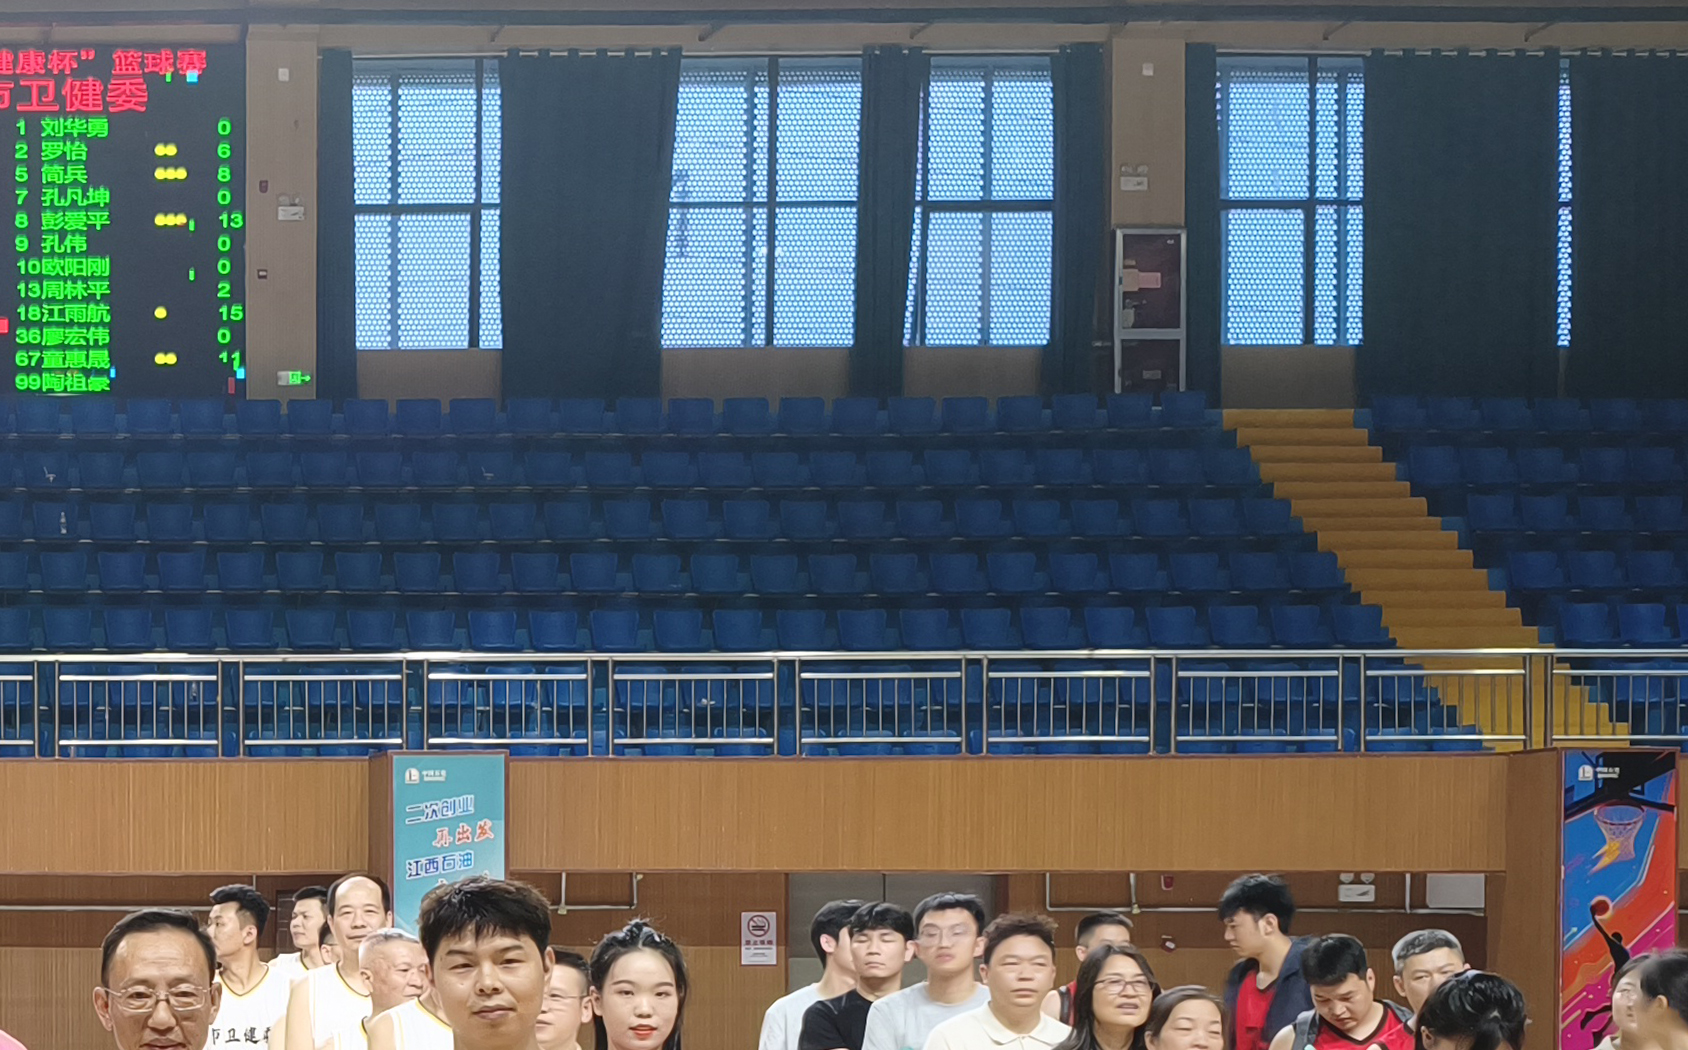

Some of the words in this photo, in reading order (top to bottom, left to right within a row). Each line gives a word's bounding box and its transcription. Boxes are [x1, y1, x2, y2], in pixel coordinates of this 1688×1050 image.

[16, 118, 26, 135] 1
[41, 115, 109, 137] 刘华勇
[217, 118, 231, 135] 0
[15, 142, 28, 158] 2
[41, 139, 87, 160] 罗怡
[217, 141, 231, 158] 6
[15, 165, 29, 182] 5
[217, 165, 231, 182] 8
[15, 189, 29, 205] 7
[41, 186, 110, 207] 孔凡坤
[217, 188, 232, 205] 0
[15, 212, 29, 228] 8
[41, 209, 111, 230] 彭爱平
[218, 211, 243, 228] 13
[15, 235, 29, 252] 9
[41, 232, 87, 254] 孔伟
[217, 234, 232, 252] 0
[17, 258, 41, 275] 10
[42, 256, 110, 276] 欧阳刚
[217, 257, 232, 275] 0
[17, 281, 41, 298] 13
[42, 279, 111, 300] 周林平
[217, 281, 231, 298] 2
[17, 304, 41, 321] 18
[42, 302, 111, 323] 江雨航
[218, 304, 243, 321] 15
[15, 328, 41, 344] 36
[217, 327, 232, 344] 0
[15, 351, 41, 367] 67
[15, 373, 41, 390] 99
[406, 796, 474, 823] 二次创业
[407, 852, 473, 878] 江西石油
